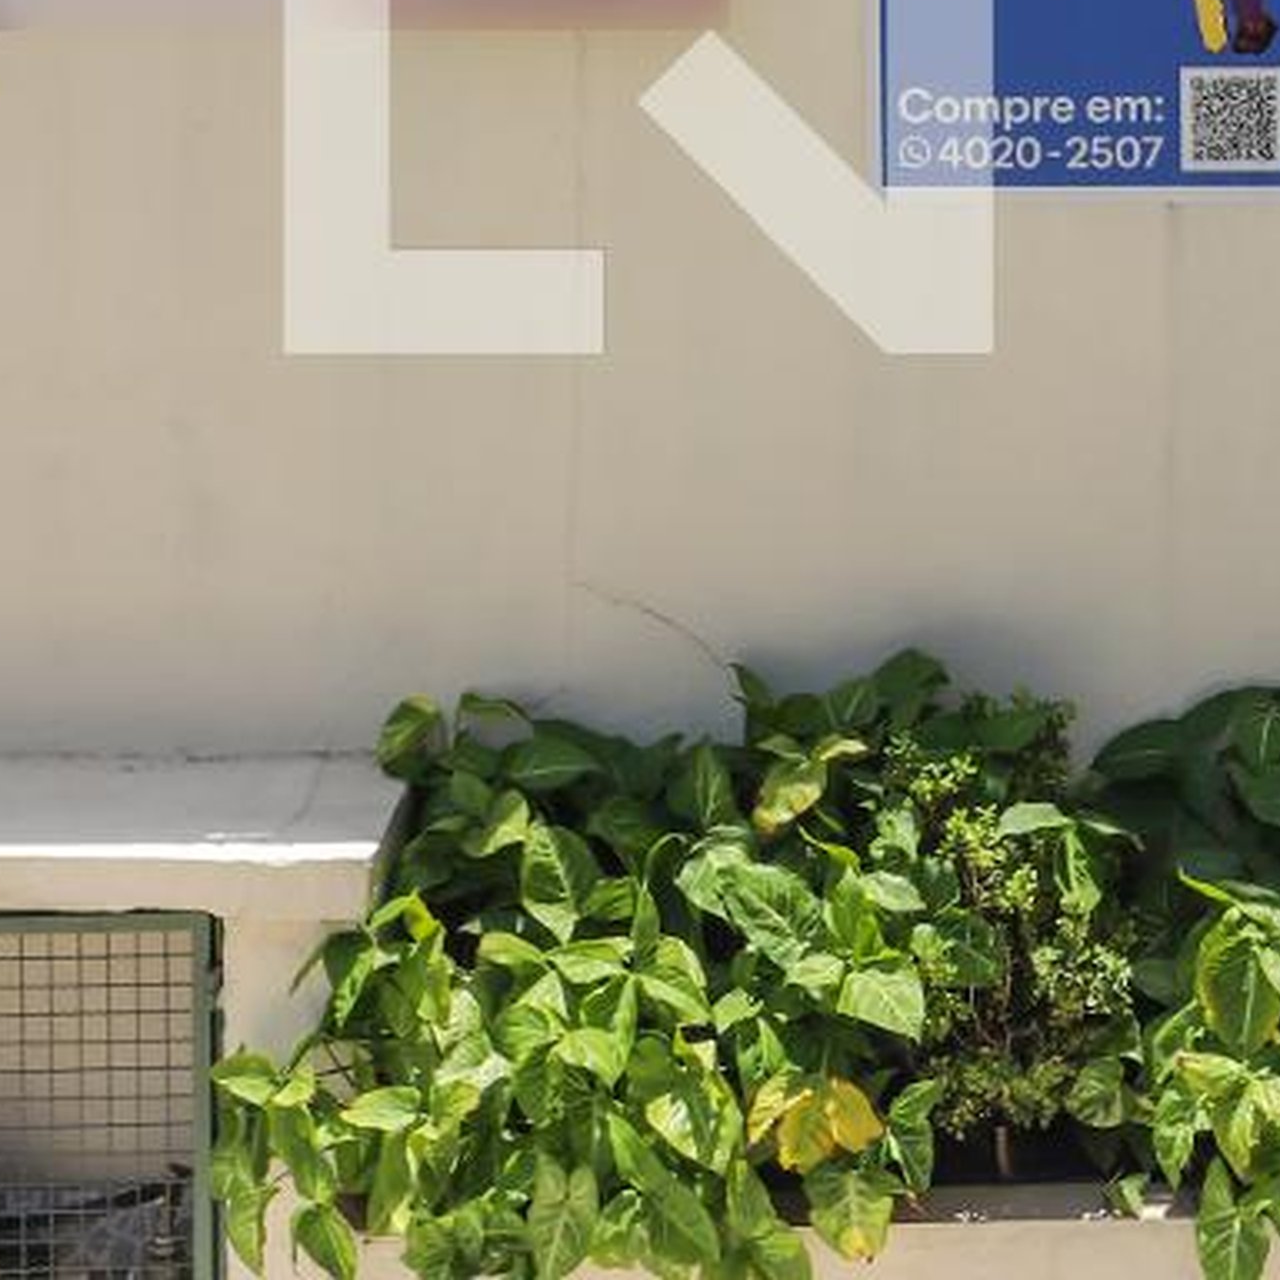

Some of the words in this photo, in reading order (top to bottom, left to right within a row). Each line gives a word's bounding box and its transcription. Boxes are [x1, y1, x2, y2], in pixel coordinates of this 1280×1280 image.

[898, 88, 1076, 130] Compre
[1086, 93, 1164, 123] em:
[938, 137, 1163, 171] 4020-2507
